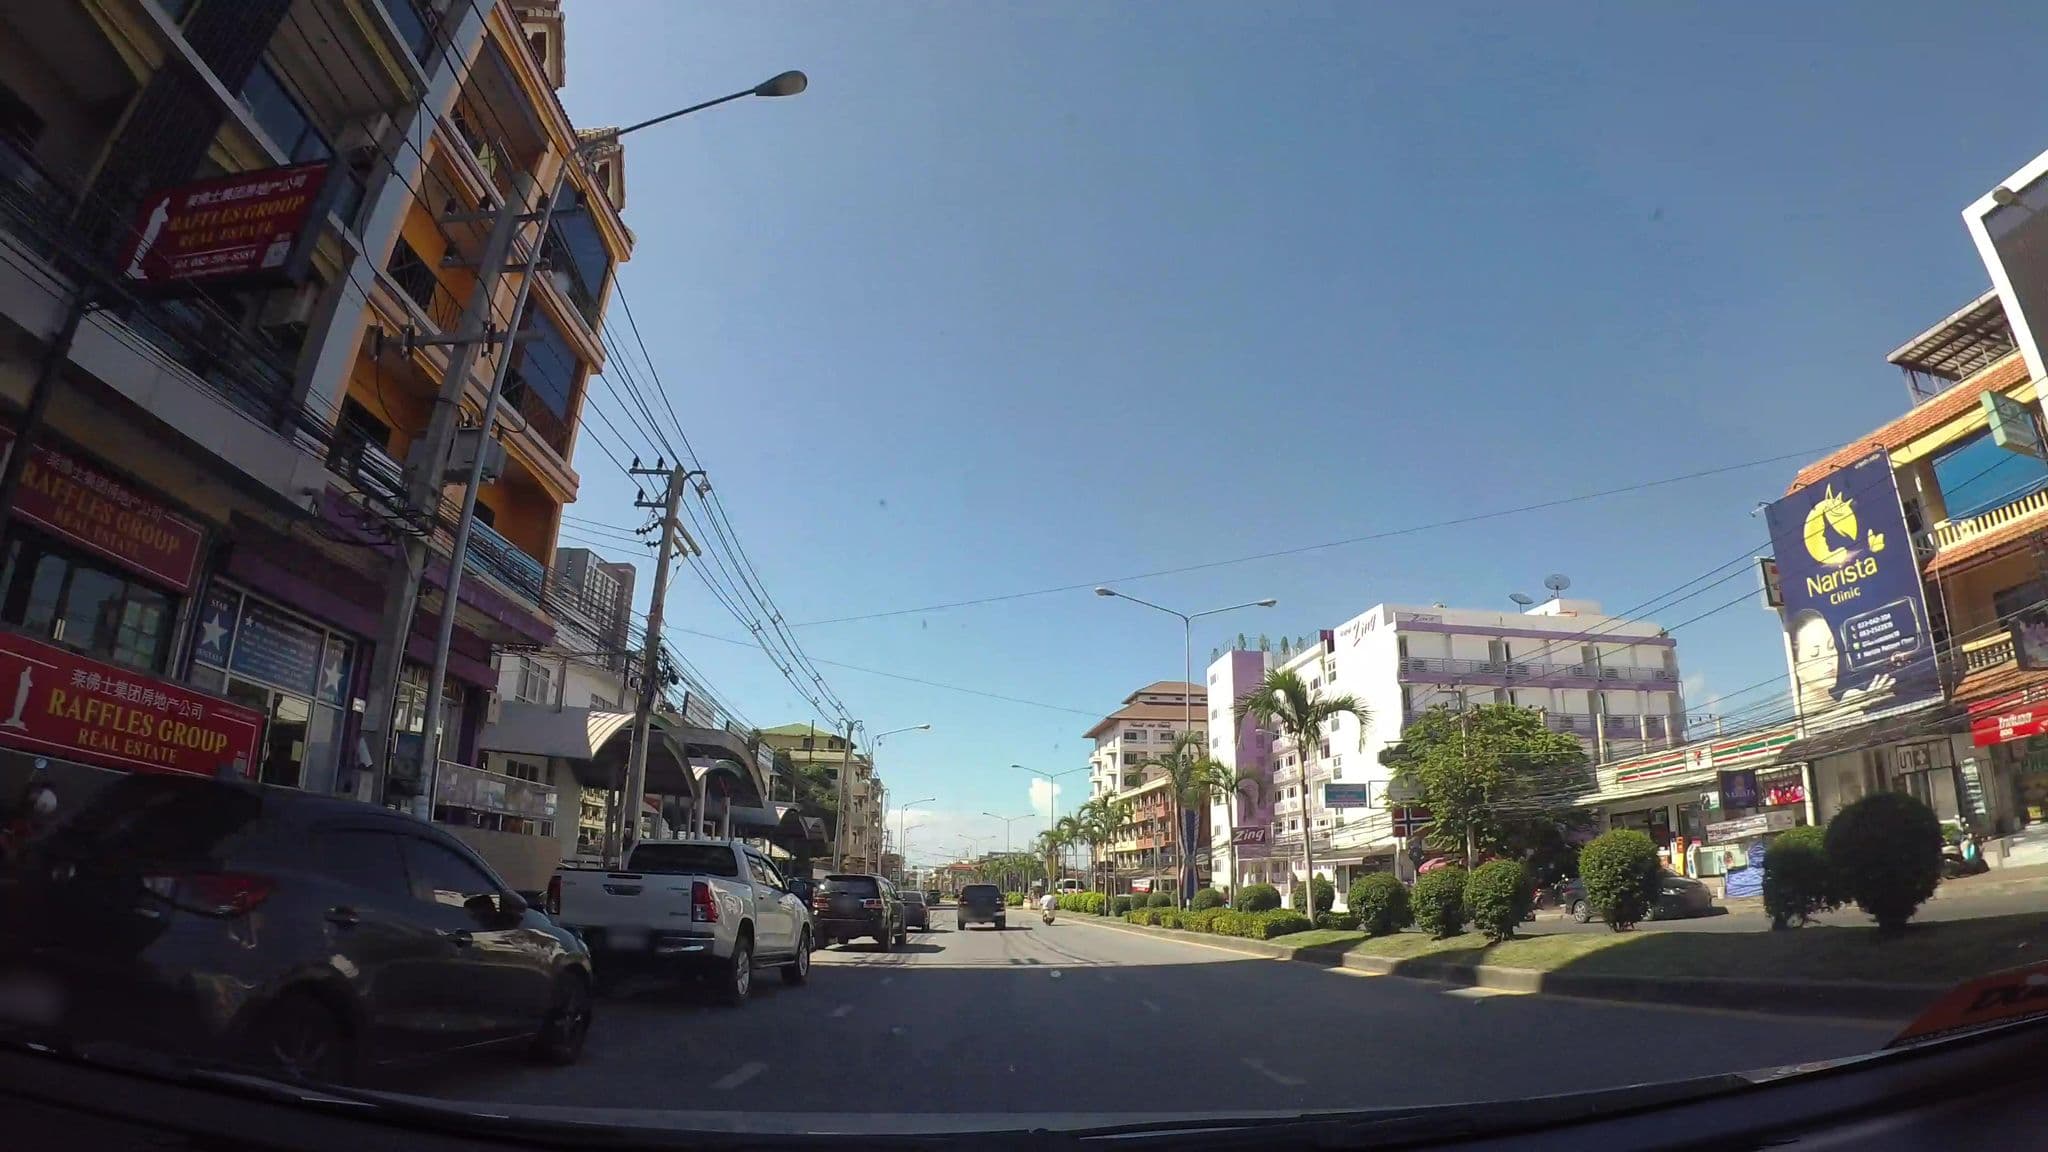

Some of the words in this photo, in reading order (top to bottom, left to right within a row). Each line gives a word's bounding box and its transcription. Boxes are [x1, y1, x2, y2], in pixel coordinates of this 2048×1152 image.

[244, 195, 305, 219] GROUP
[20, 458, 114, 525] RAFFLES
[116, 511, 182, 556] GROUP
[1806, 557, 1878, 598] Narista
[1830, 587, 1861, 605] Clinic
[70, 668, 205, 721] 莱佛士集团房地产公司
[47, 687, 154, 738] RAFFLES
[157, 718, 229, 756] GROUP
[77, 727, 119, 752] REAL
[124, 738, 177, 765] ESTATE
[1232, 829, 1265, 842] Zing
